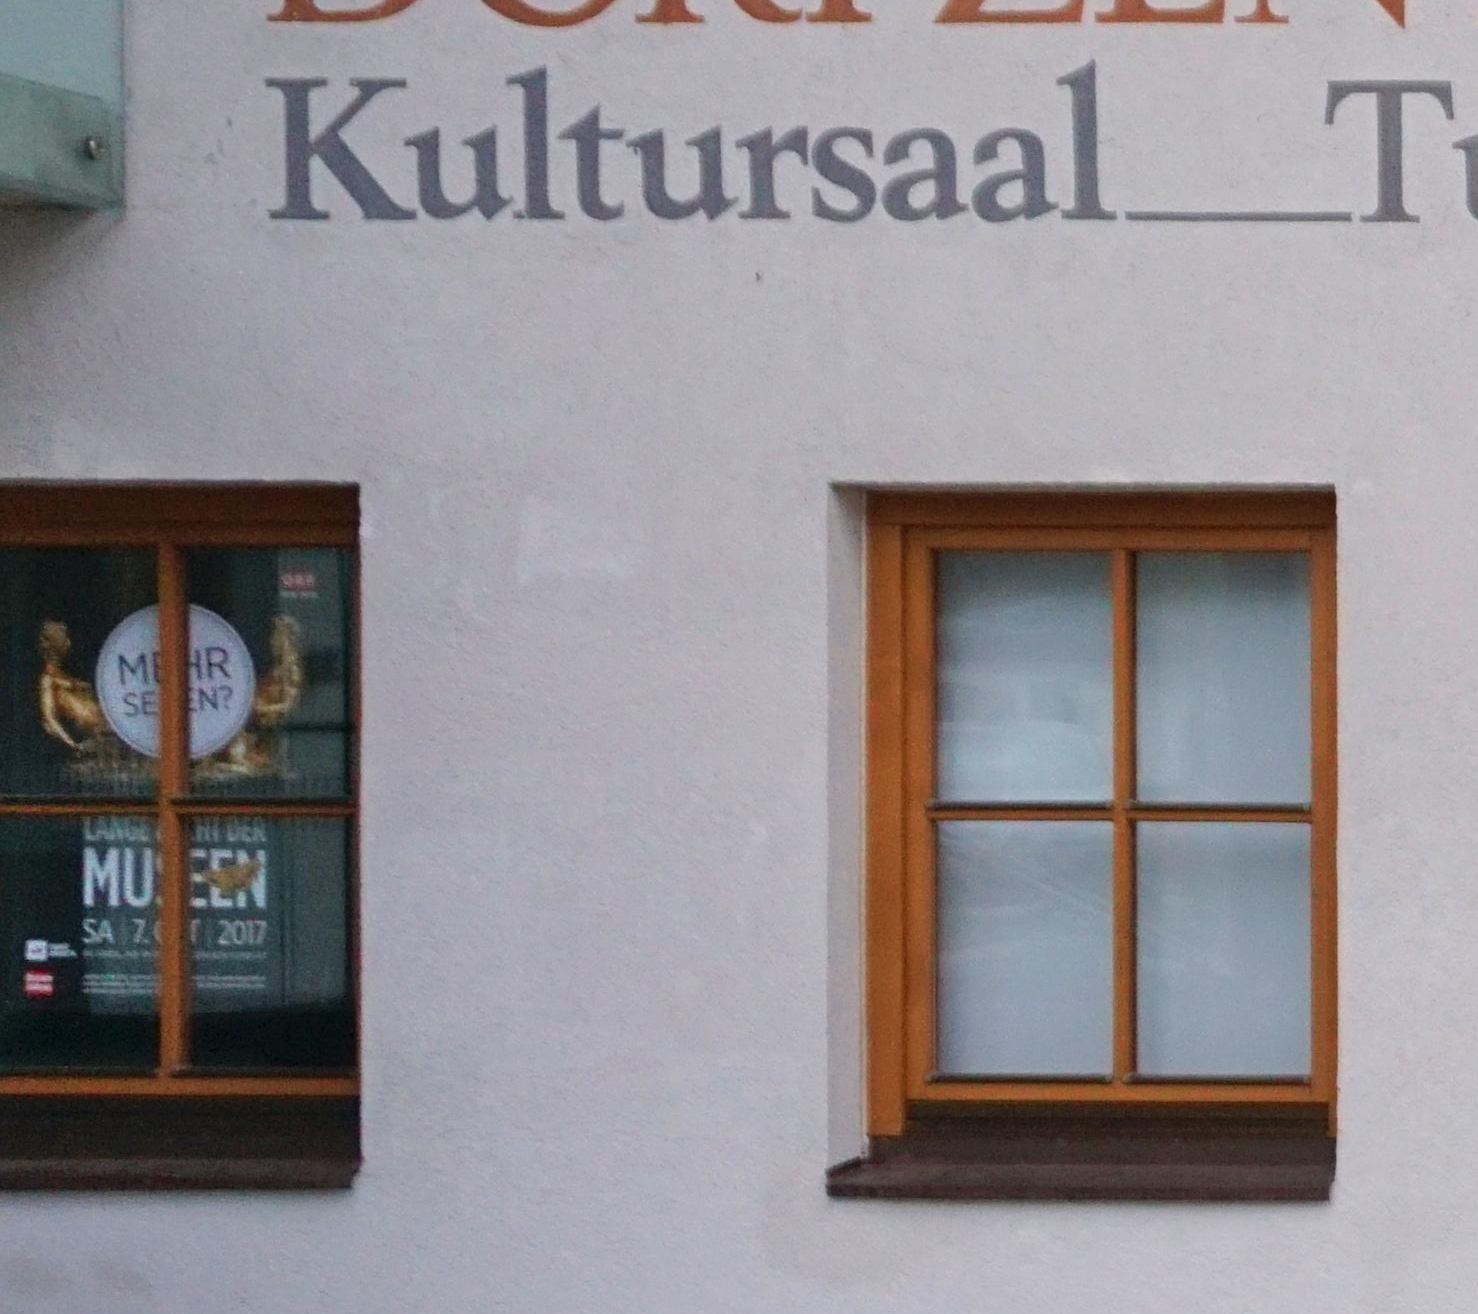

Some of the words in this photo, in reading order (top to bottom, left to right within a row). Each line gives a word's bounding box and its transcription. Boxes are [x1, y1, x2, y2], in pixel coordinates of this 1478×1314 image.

[264, 60, 1117, 223] Kultursaal
[121, 686, 234, 718] SEEN?
[82, 918, 115, 944] SA
[217, 919, 268, 946] 2017
